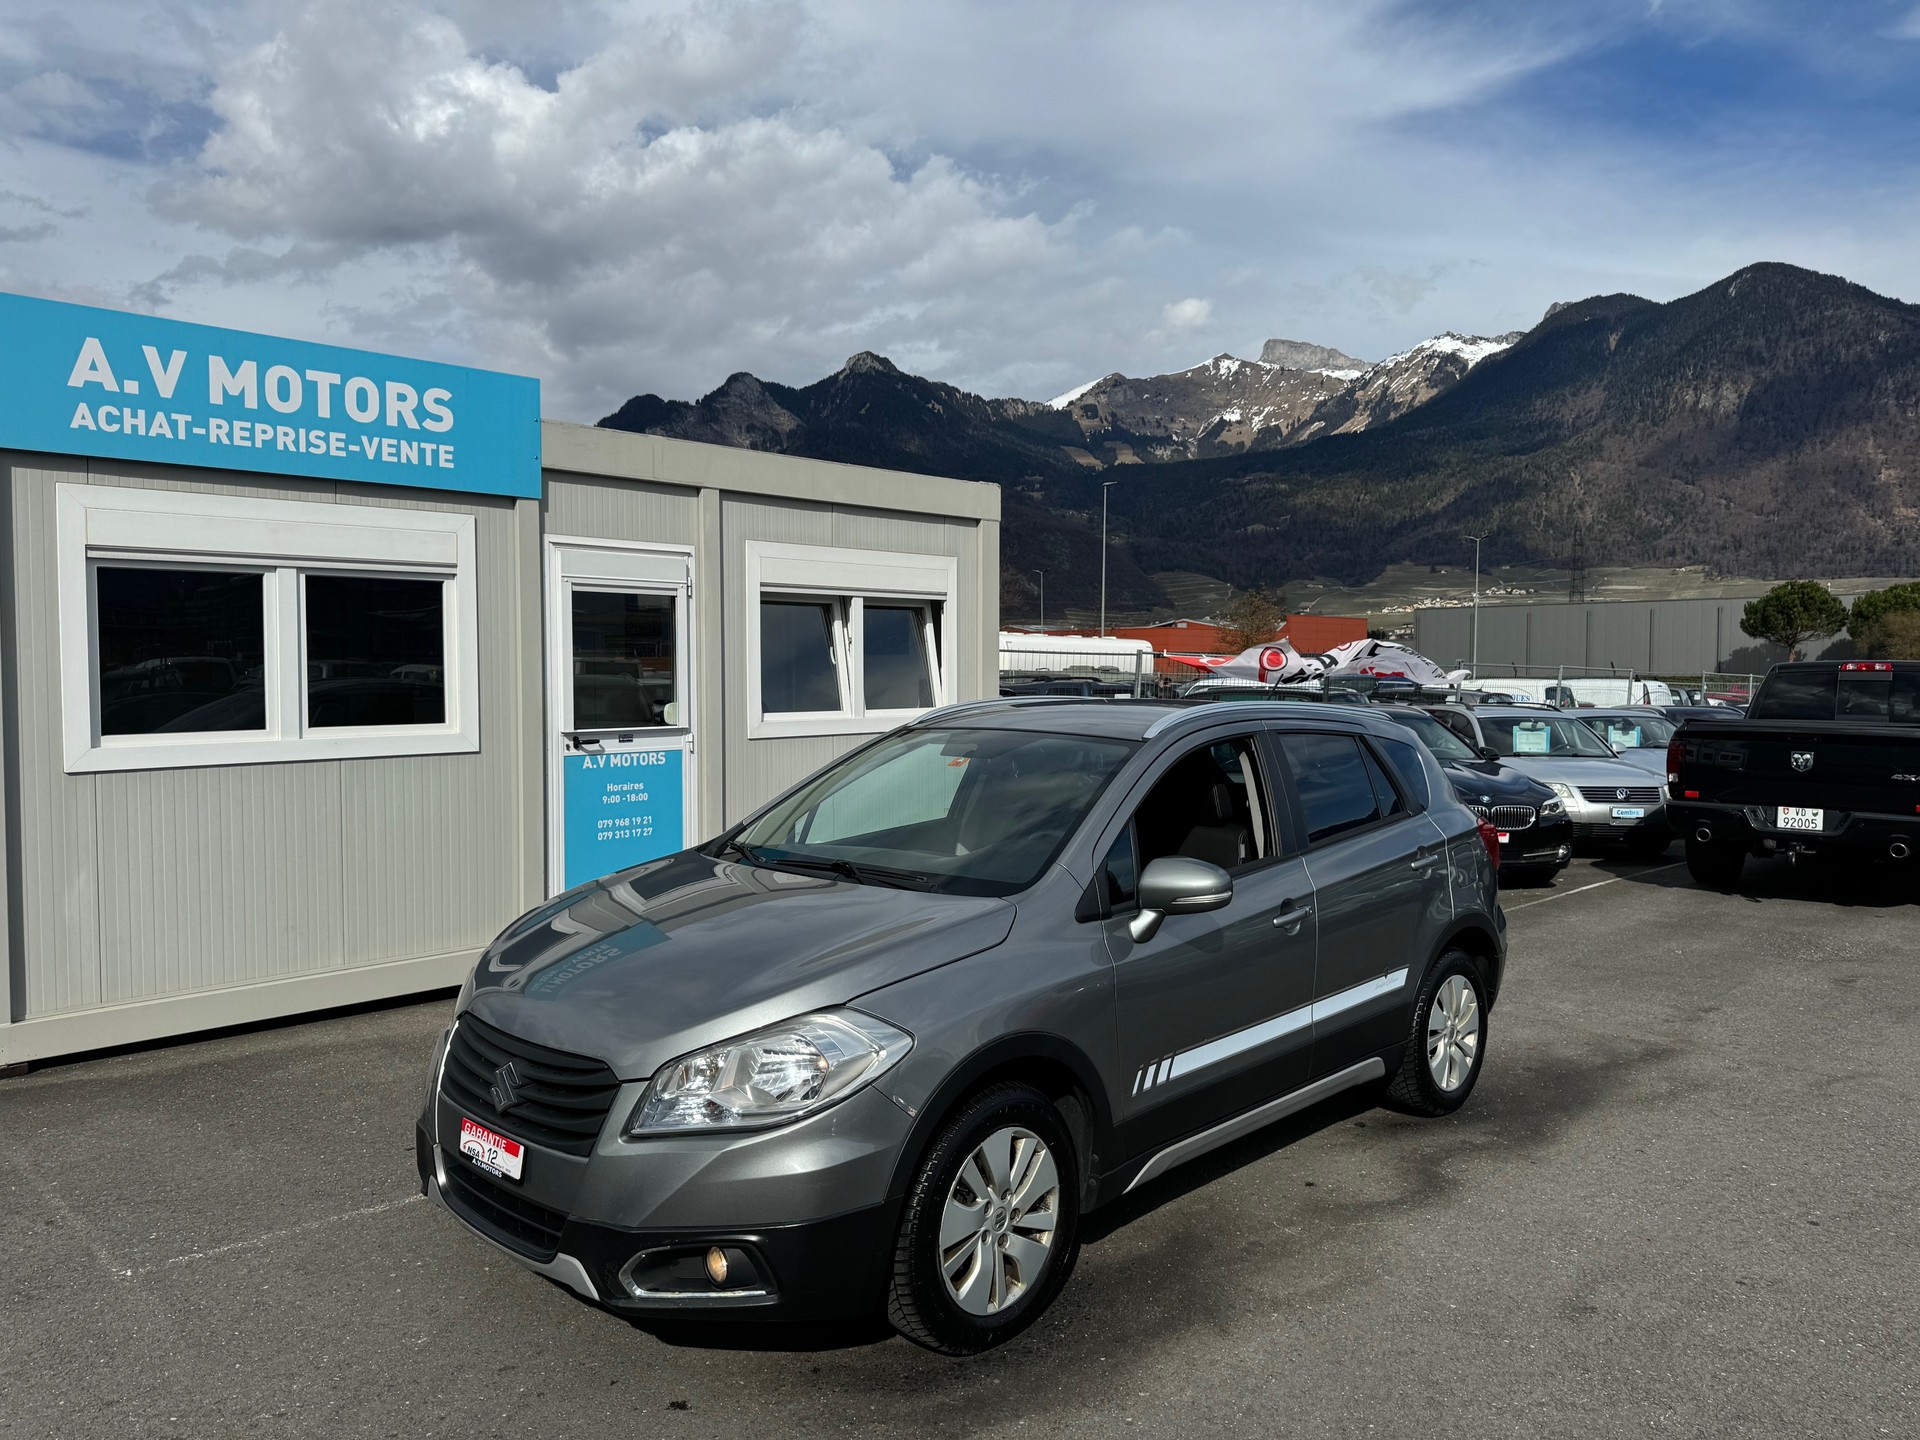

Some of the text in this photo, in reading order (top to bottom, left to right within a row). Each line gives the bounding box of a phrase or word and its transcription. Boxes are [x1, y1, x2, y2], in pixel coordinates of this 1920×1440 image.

[67, 337, 455, 433] A.V MOTORS
[70, 402, 455, 469] ACHAT-REPRISE-VENTE
[582, 752, 666, 769] A.V MOTORS
[607, 782, 644, 792] Horaires
[602, 795, 620, 804] 9:00
[1795, 808, 1806, 816] VD
[597, 816, 652, 828] 079 968 19 21
[1783, 817, 1817, 829] 92005
[597, 828, 653, 840] 079 313 17 27
[464, 1122, 507, 1152] GARANTIE
[467, 1146, 480, 1158] NSA
[487, 1147, 498, 1165] 12
